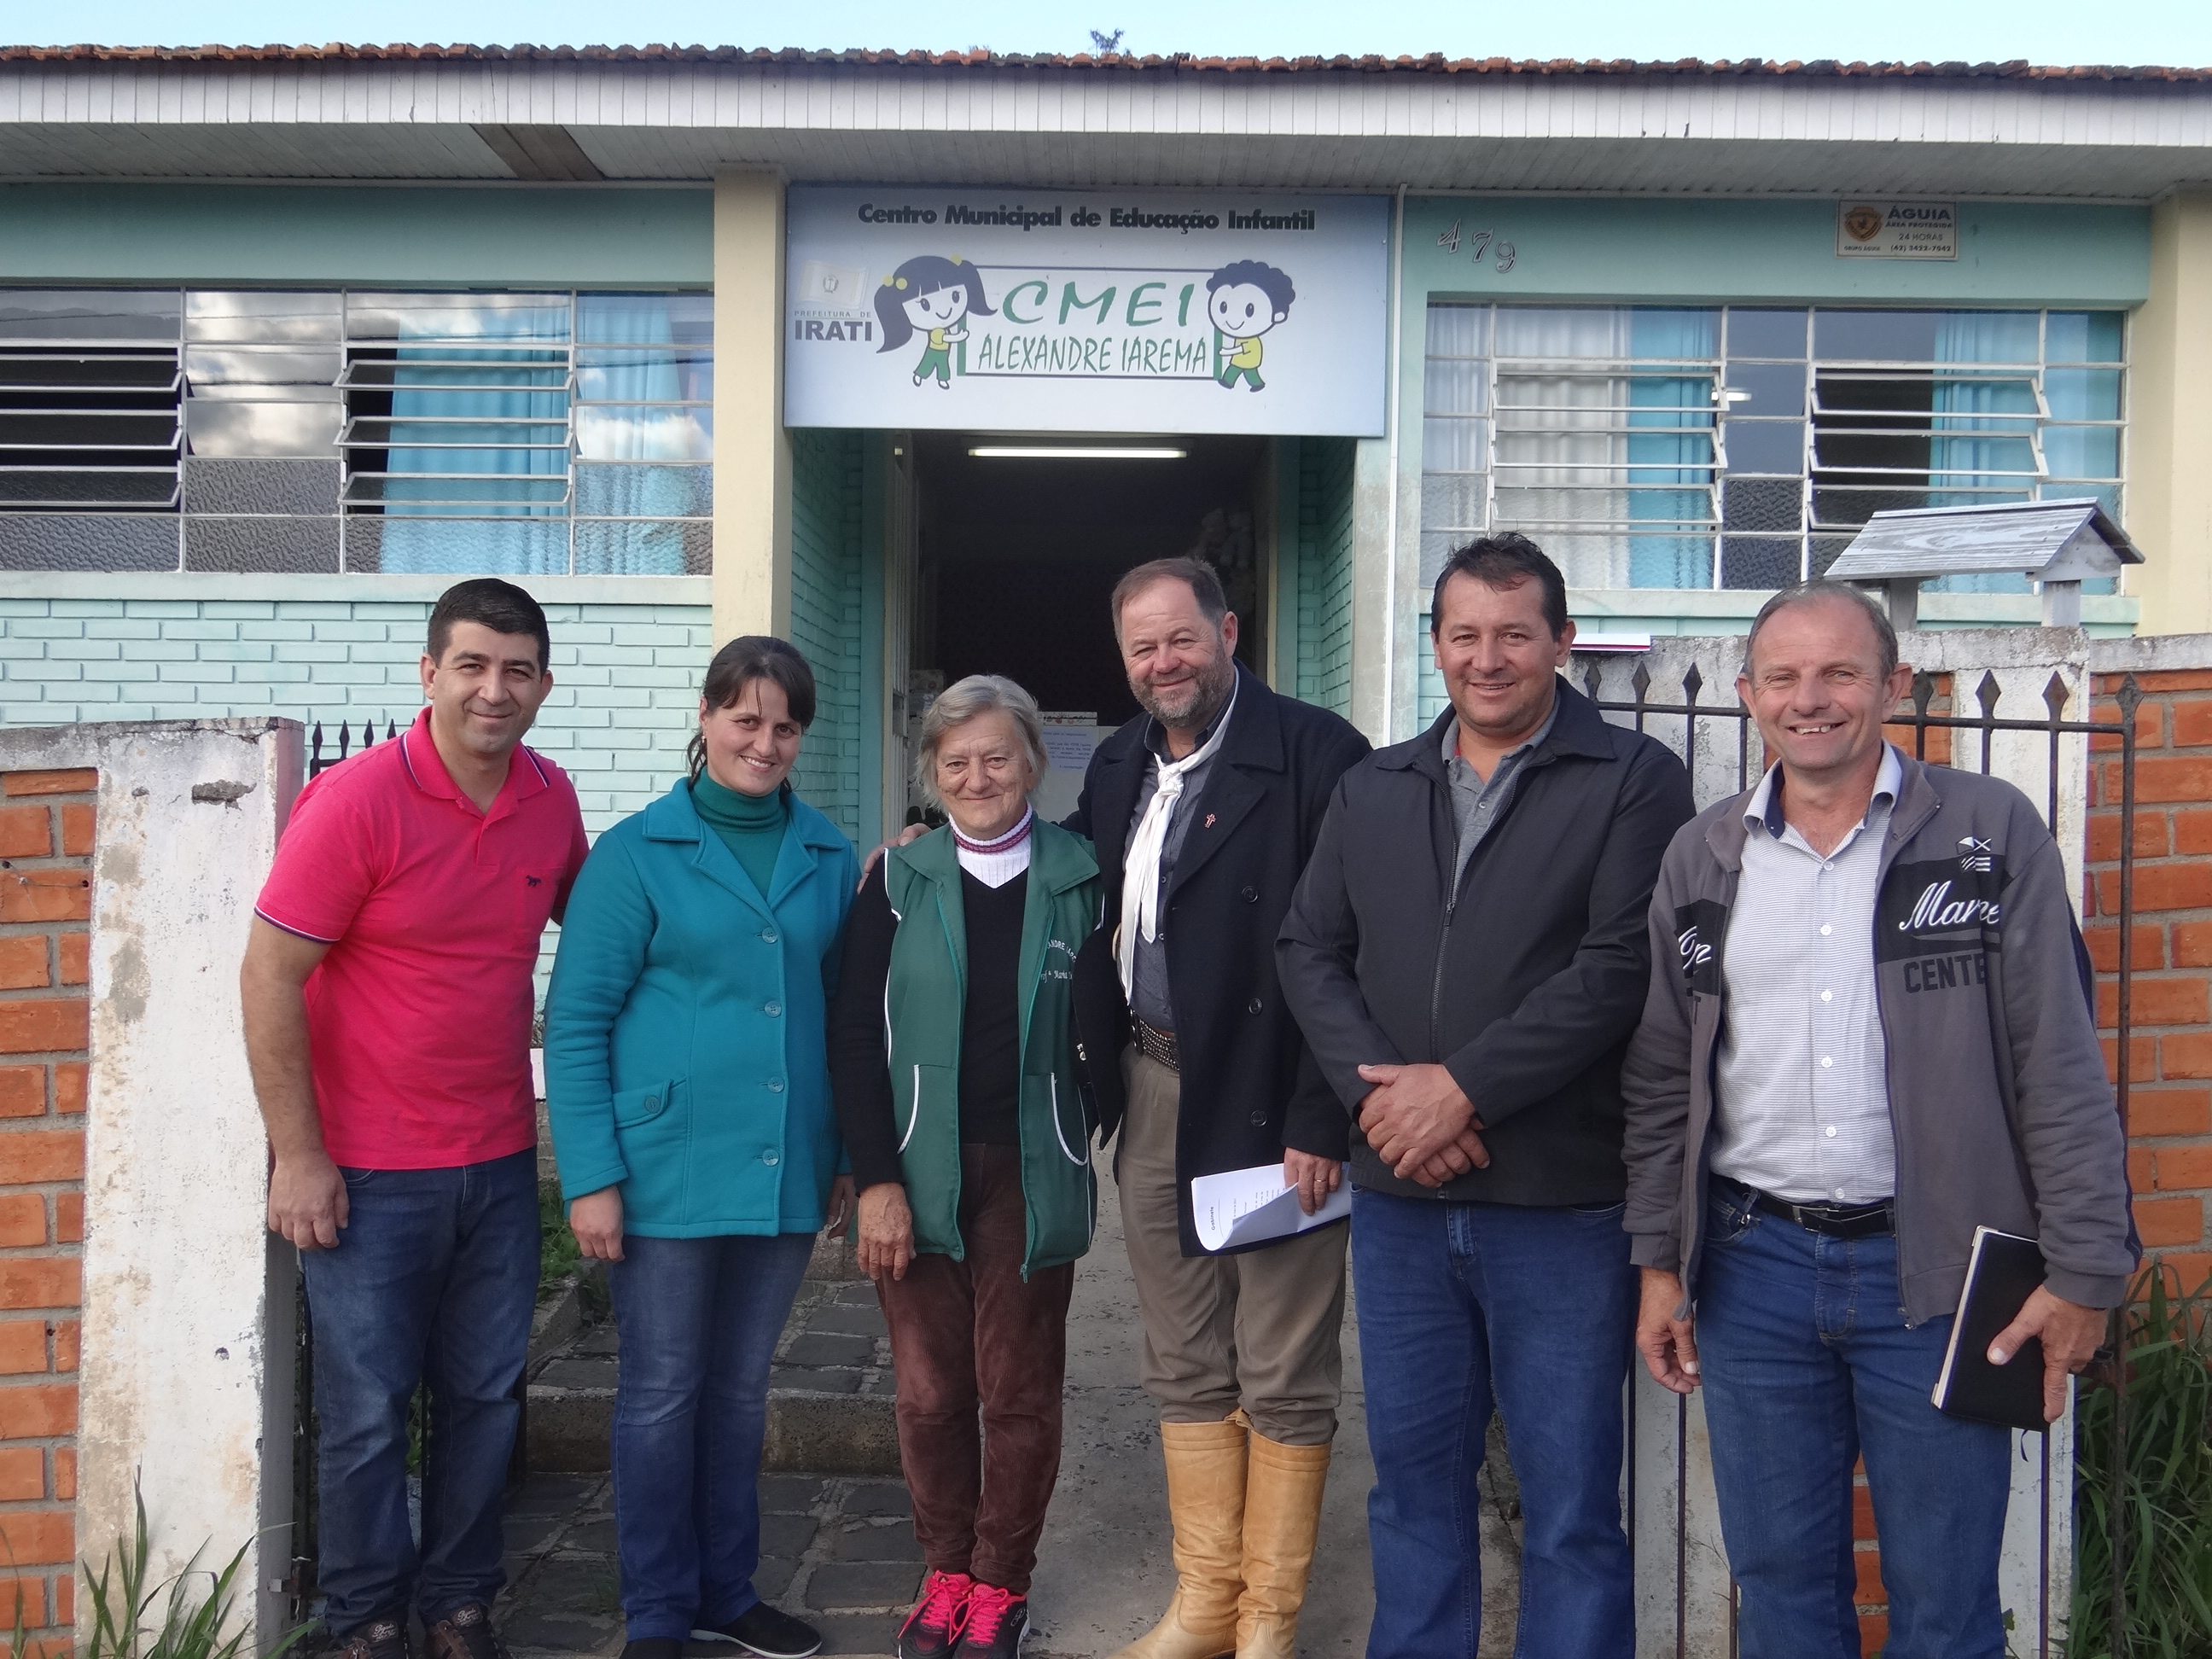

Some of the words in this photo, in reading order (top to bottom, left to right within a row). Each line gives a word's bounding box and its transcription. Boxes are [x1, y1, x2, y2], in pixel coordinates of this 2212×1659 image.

[858, 203, 937, 224] Centro
[945, 204, 1062, 231] Municipal
[1069, 207, 1102, 227] de
[1109, 207, 1220, 235] Educação
[1227, 209, 1315, 230] Infantil
[1887, 206, 1951, 220] ÁGUIA
[1436, 218, 1516, 273] 479
[1912, 233, 1943, 242] HORAS
[1002, 280, 1195, 327] CMEI
[795, 320, 872, 341] IRATI
[978, 333, 1113, 373] ALEXANDRE
[1121, 335, 1206, 374] IAREMA
